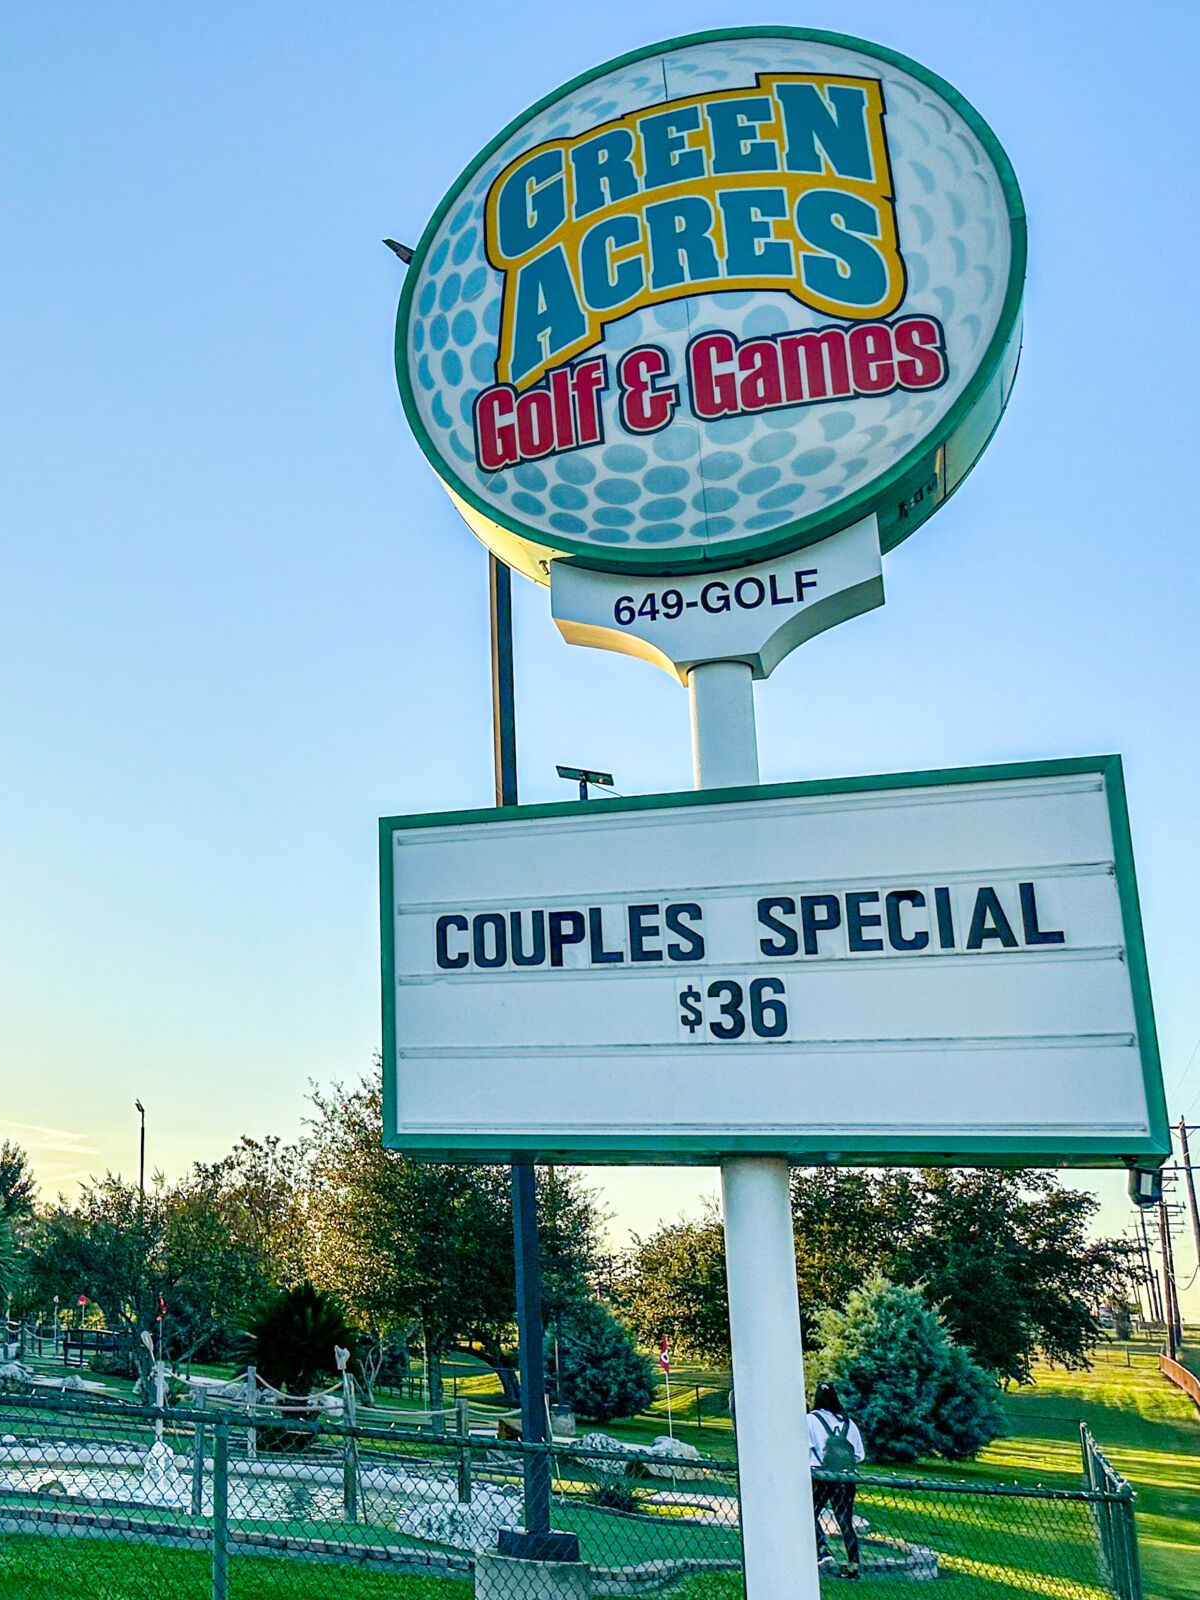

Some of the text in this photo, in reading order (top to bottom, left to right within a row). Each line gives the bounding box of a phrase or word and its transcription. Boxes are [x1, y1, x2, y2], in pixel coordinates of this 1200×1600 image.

[497, 81, 876, 260] GREEN
[507, 187, 889, 384] ACRES
[478, 319, 946, 470] Golf & Games
[613, 569, 818, 626] 649-GOLF
[435, 881, 1065, 969] COUPLES SPECIAL
[679, 977, 788, 1039] $36
